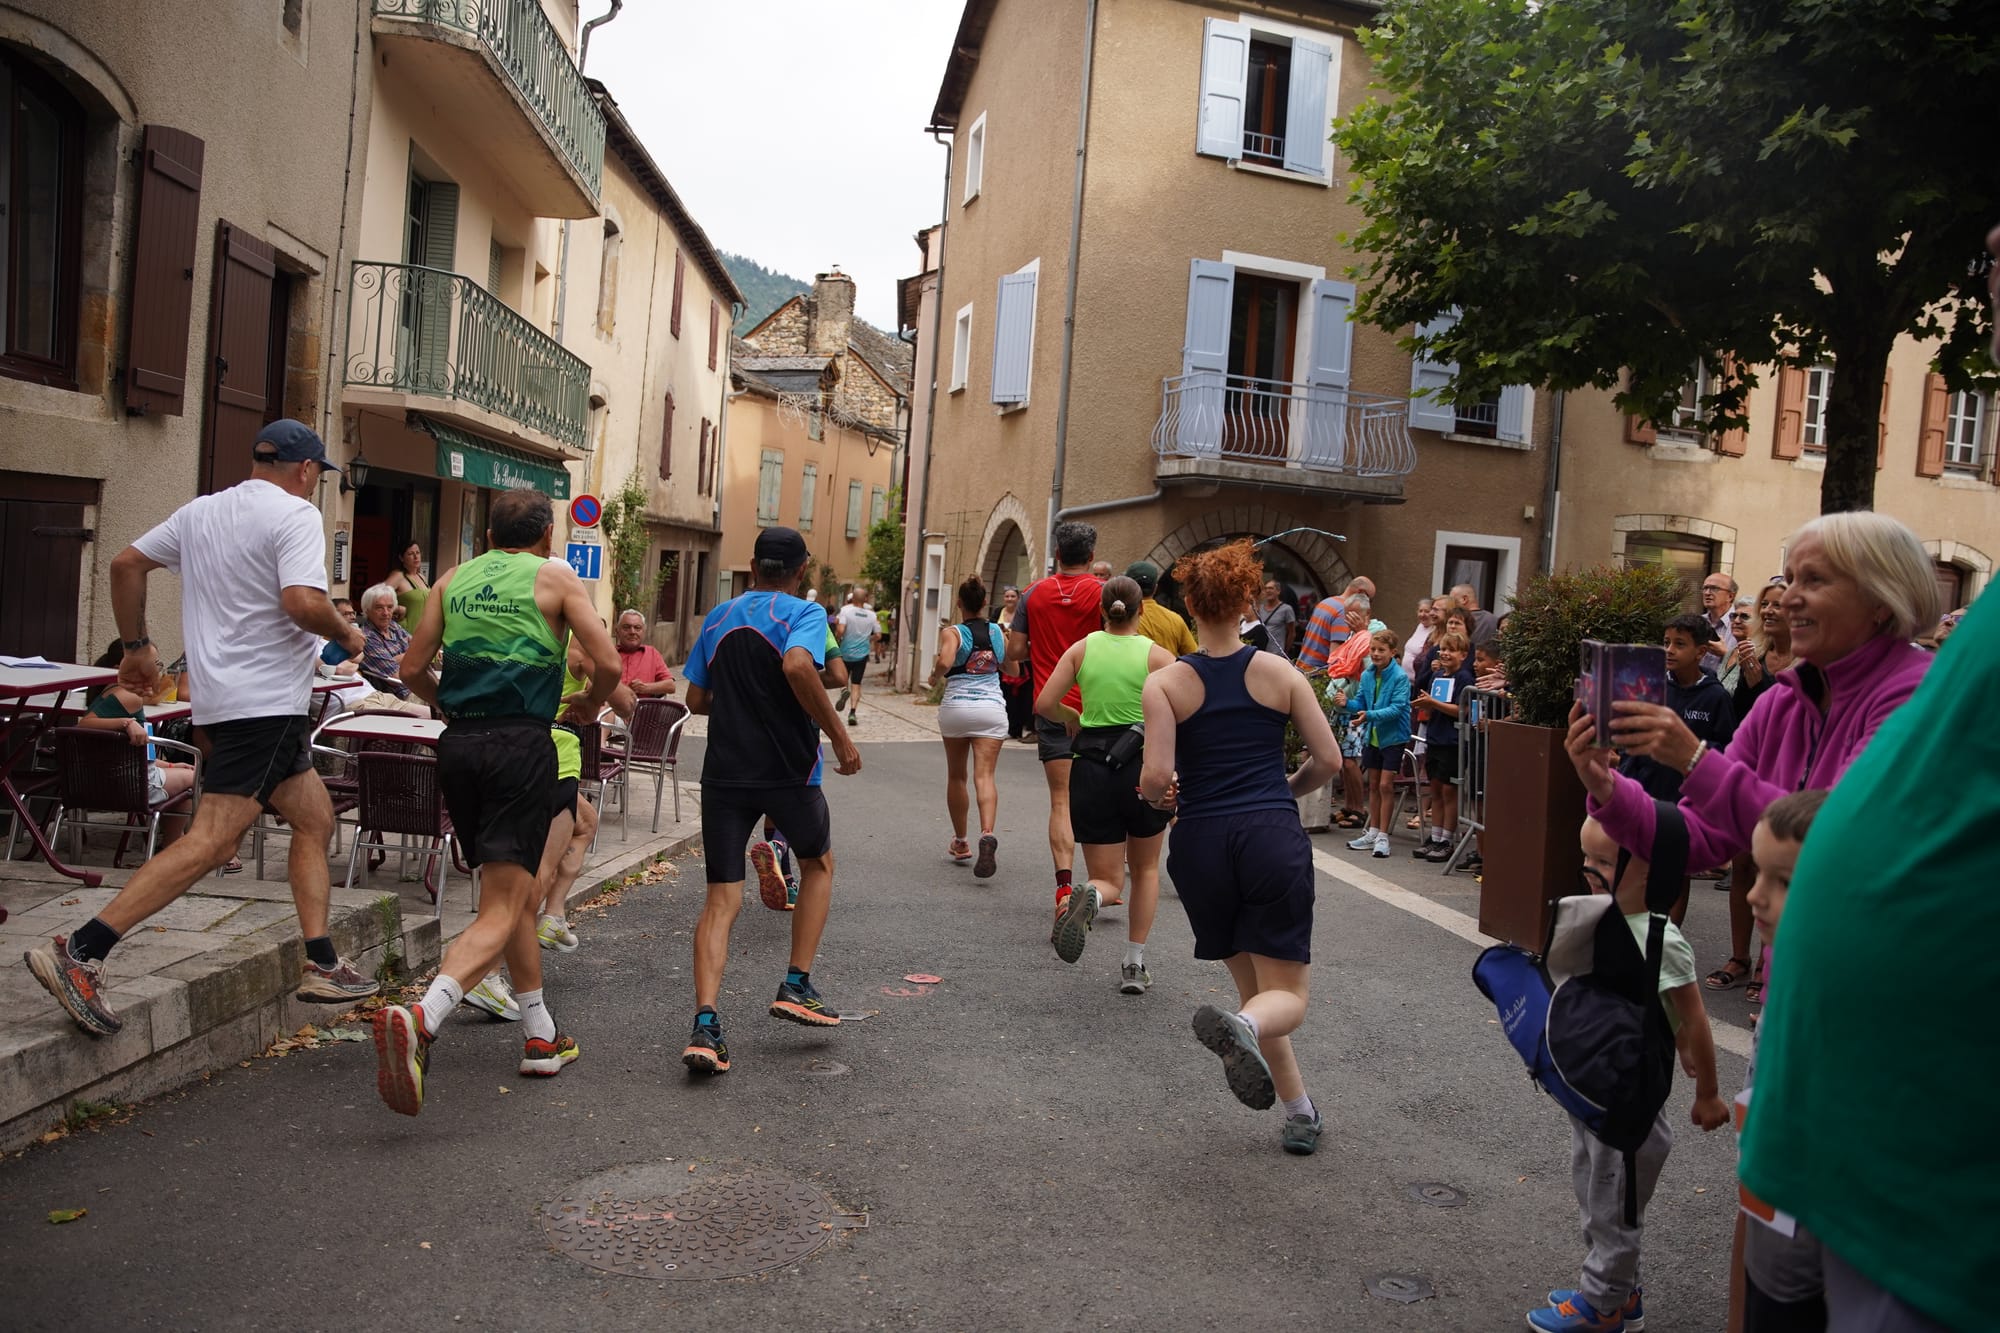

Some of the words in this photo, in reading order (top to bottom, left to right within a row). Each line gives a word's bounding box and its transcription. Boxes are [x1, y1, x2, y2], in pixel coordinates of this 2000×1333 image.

[450, 596, 520, 620] Marvejols
[1435, 686, 1441, 697] 2
[1683, 708, 1711, 722] NRGX
